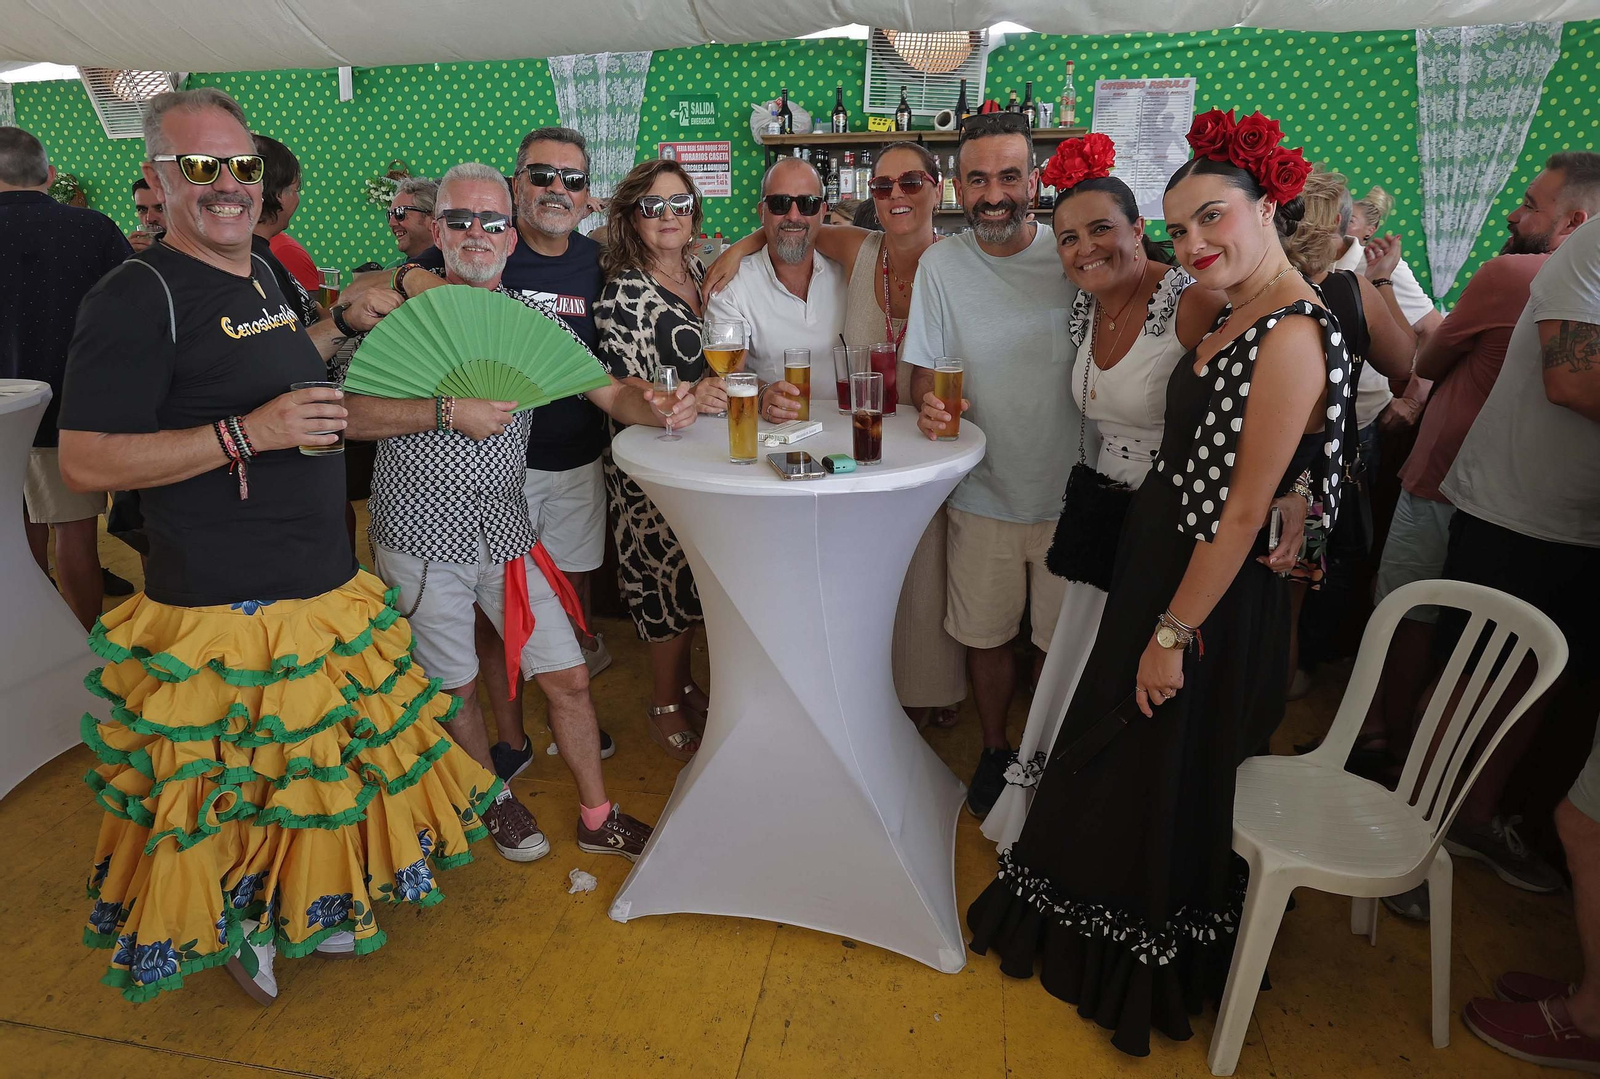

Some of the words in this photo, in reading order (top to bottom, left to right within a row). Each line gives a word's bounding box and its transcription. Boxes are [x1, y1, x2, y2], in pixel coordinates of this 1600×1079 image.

[691, 101, 715, 115] SALIDA
[691, 117, 715, 125] EMERGENCIA
[681, 153, 708, 161] HORARIOS
[708, 152, 729, 161] CASETA
[707, 163, 729, 171] DOMINGO
[556, 297, 585, 315] JEANS
